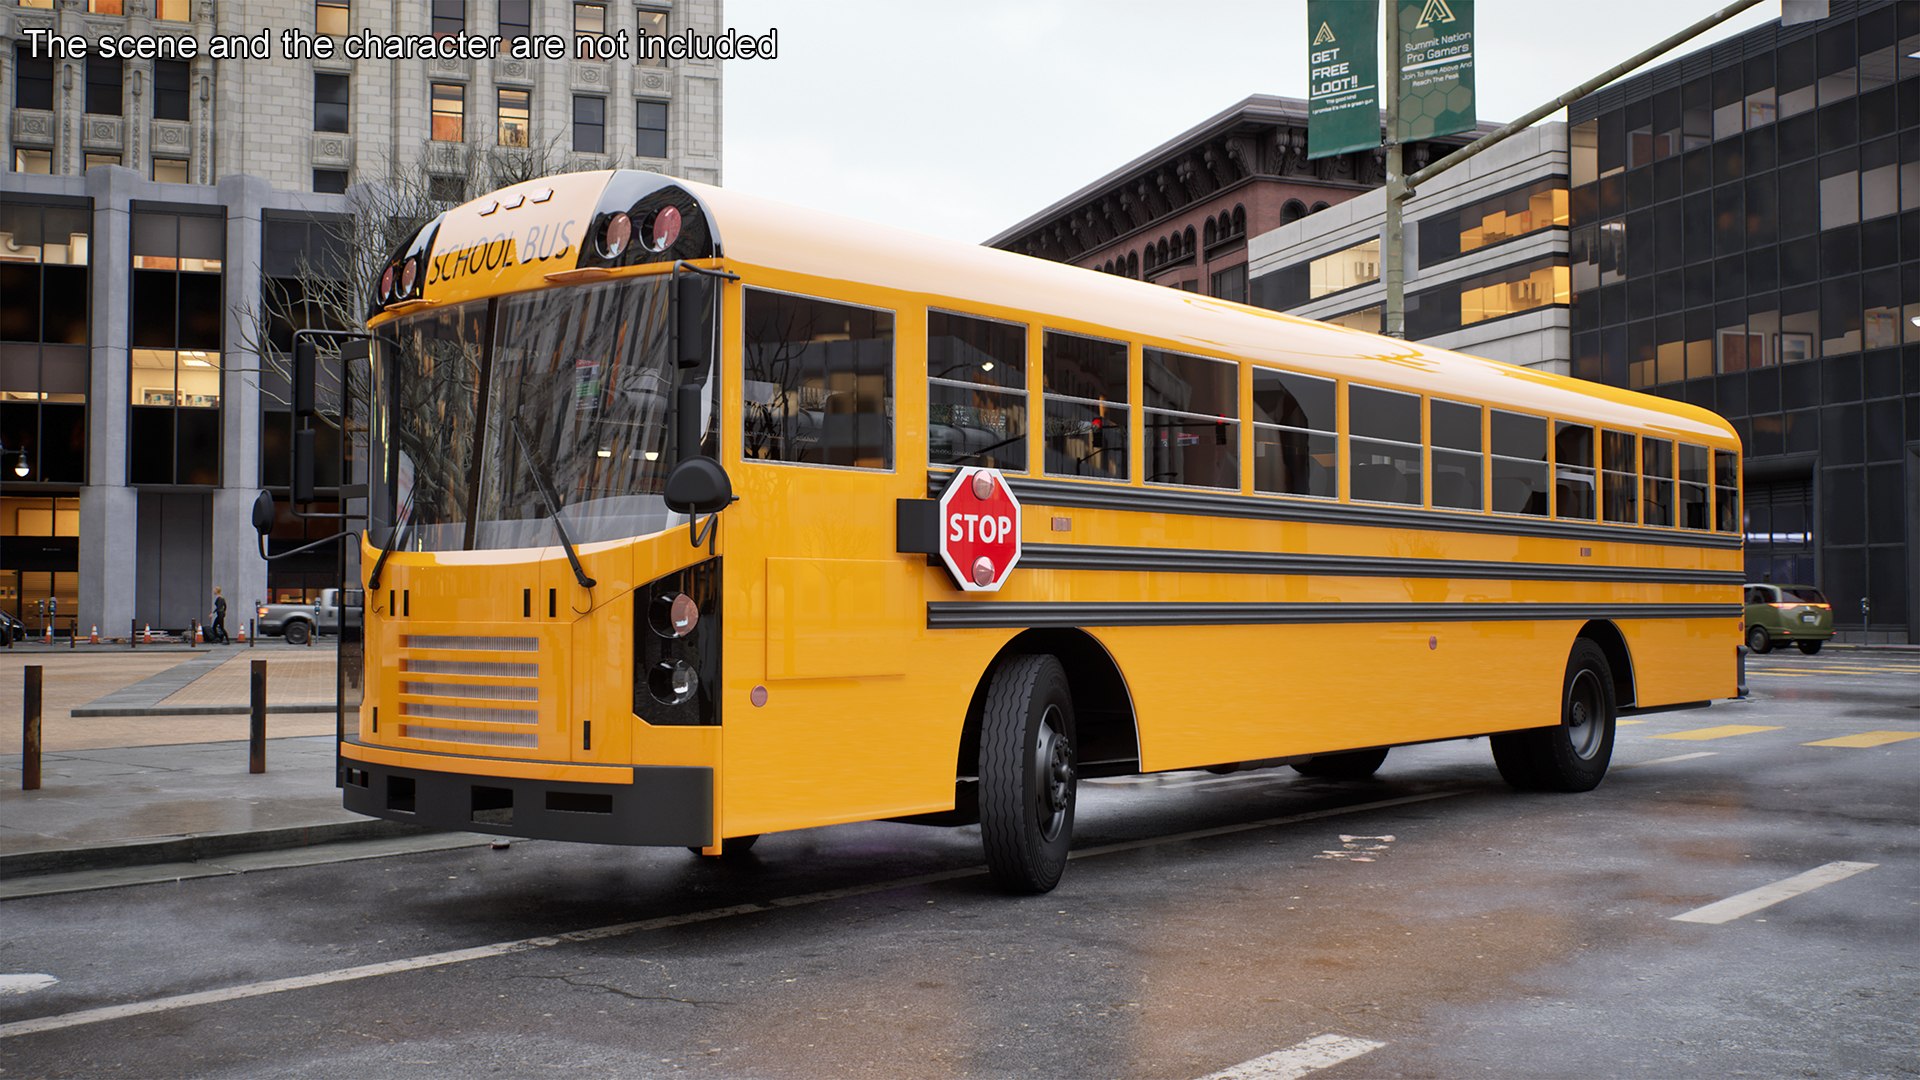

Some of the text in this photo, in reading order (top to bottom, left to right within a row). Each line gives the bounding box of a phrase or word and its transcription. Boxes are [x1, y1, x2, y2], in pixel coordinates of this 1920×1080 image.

[1405, 32, 1471, 52] Summit Nation
[1311, 47, 1340, 65] GET
[1407, 43, 1469, 64] Pro Gamers
[1312, 61, 1350, 81] FREE
[1439, 65, 1459, 73] Above
[1460, 61, 1472, 69] And
[1312, 75, 1358, 96] LOOT!!
[428, 219, 577, 286] SCHOOL BUS
[949, 512, 1012, 544] STOP
